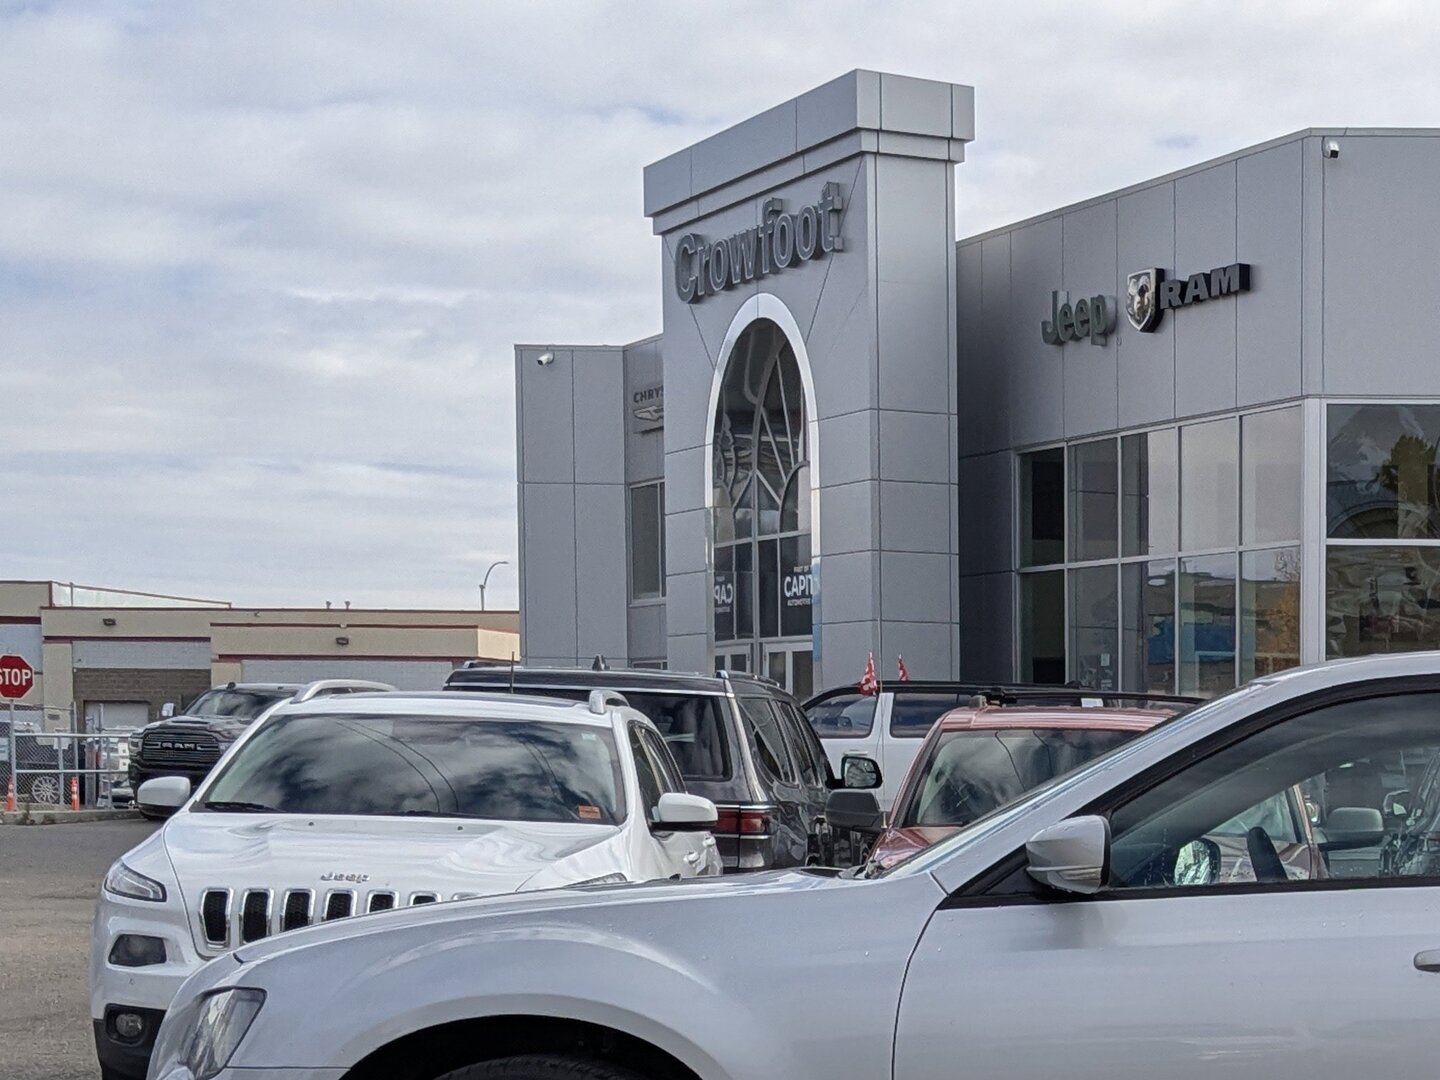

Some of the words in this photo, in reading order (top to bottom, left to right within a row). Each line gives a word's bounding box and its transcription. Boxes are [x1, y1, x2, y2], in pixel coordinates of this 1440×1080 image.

[675, 182, 843, 304] Crowfoot
[1160, 263, 1249, 310] RAM
[1041, 290, 1116, 346] Jeep
[320, 872, 370, 884] Jeep
